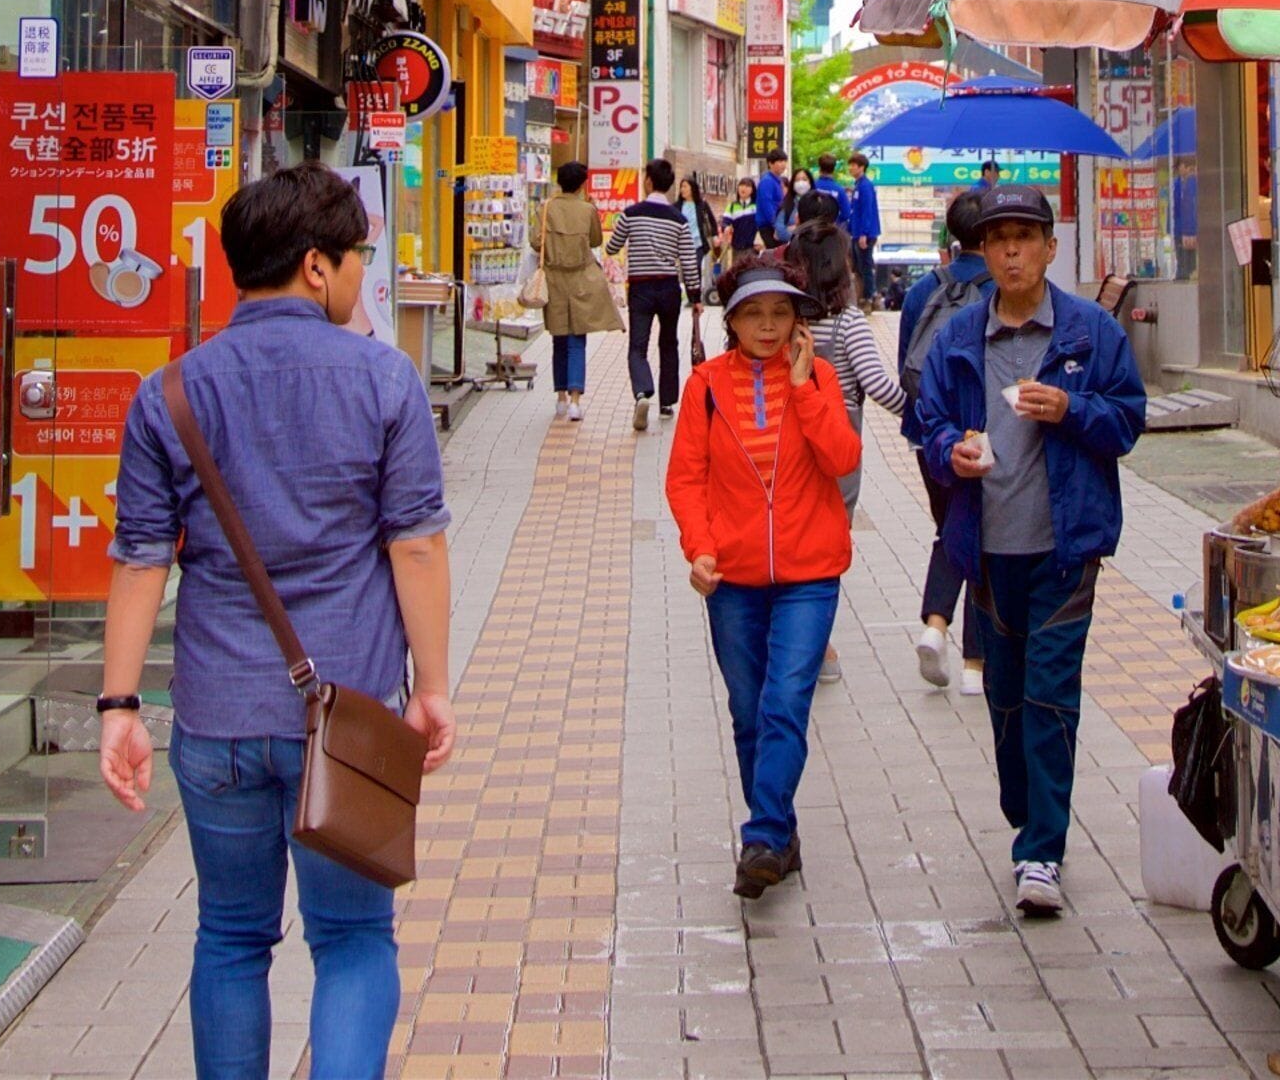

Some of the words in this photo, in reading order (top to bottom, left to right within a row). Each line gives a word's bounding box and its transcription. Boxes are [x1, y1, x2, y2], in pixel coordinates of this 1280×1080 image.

[606, 49, 624, 62] 3F
[10, 101, 67, 132] 쿠션
[72, 102, 158, 133] 전품목
